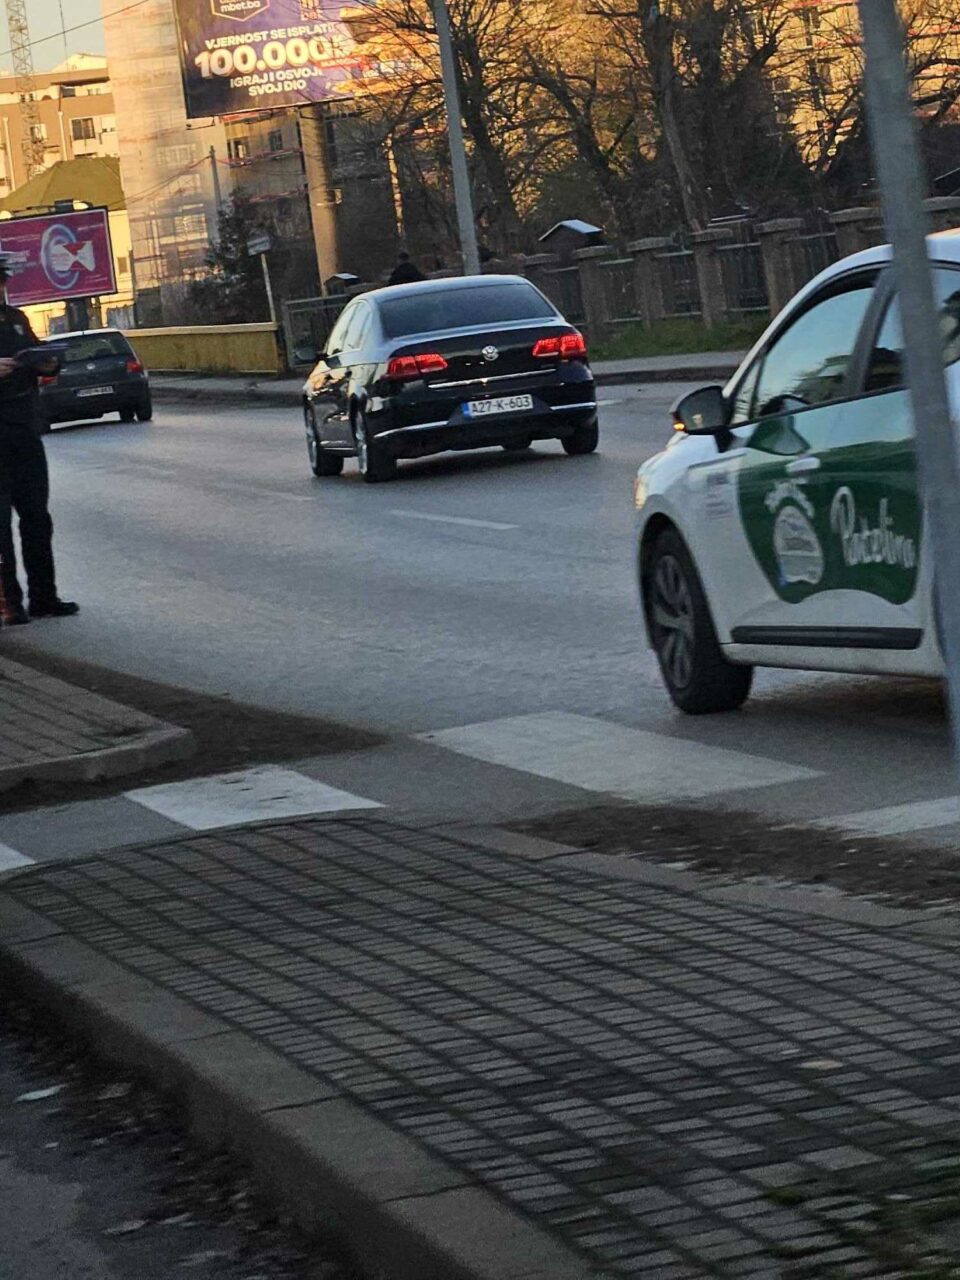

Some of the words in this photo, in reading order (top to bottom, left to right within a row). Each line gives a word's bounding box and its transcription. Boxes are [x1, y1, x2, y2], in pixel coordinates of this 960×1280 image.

[220, 0, 261, 13] mbet.ba
[205, 32, 268, 50] VJERNOST
[271, 29, 287, 40] SE
[195, 36, 332, 78] 100.000
[230, 72, 268, 88] IGRAJ
[248, 82, 282, 96] SVOJ
[283, 79, 307, 91] DIO
[472, 396, 531, 413] A27-K-603
